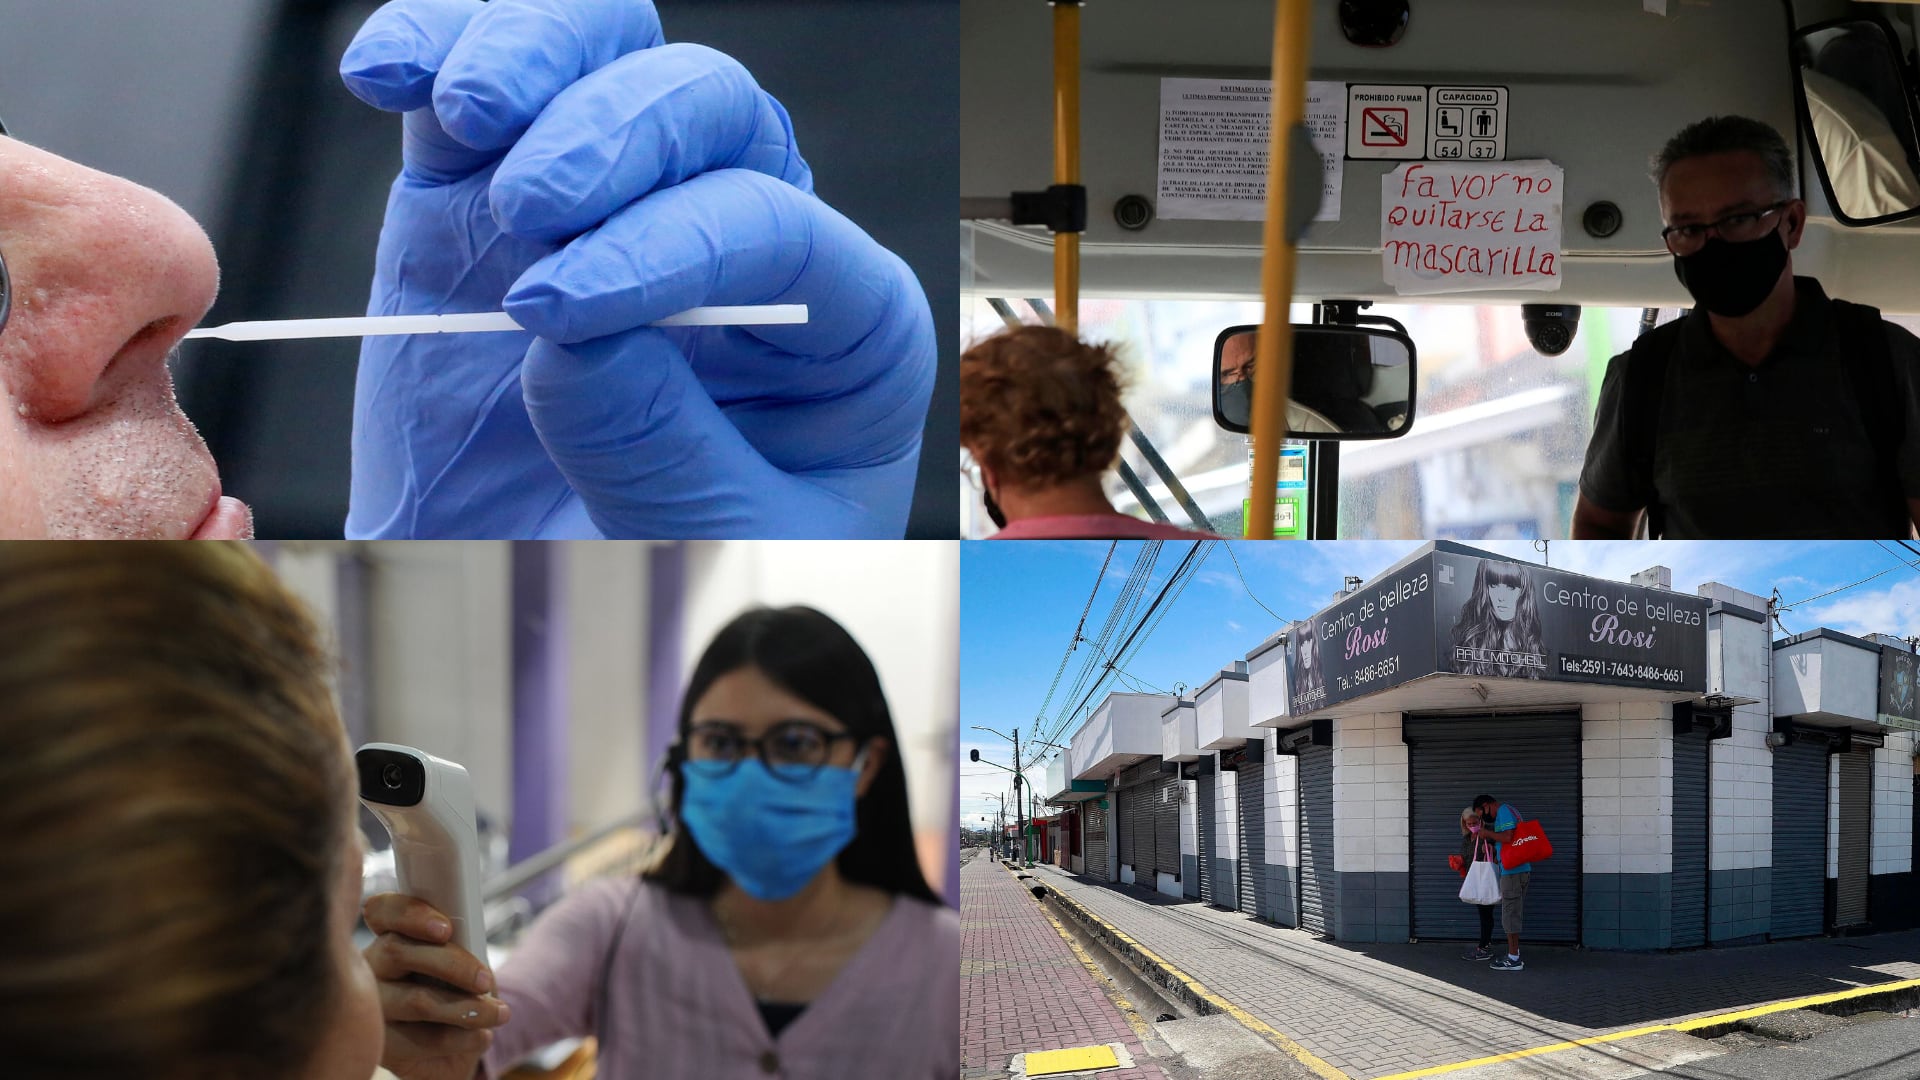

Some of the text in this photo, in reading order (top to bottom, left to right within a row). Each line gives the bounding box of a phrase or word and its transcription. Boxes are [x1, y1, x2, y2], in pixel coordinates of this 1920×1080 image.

[1354, 94, 1394, 102] PROHIBIDO
[1512, 176, 1552, 194] no
[1322, 573, 1428, 641] Centro de belleza
[1544, 582, 1700, 626] Centro de belleza
[1345, 617, 1389, 660] Rosi
[1590, 613, 1657, 649] Rosi
[1354, 656, 1400, 686] 8486-6651
